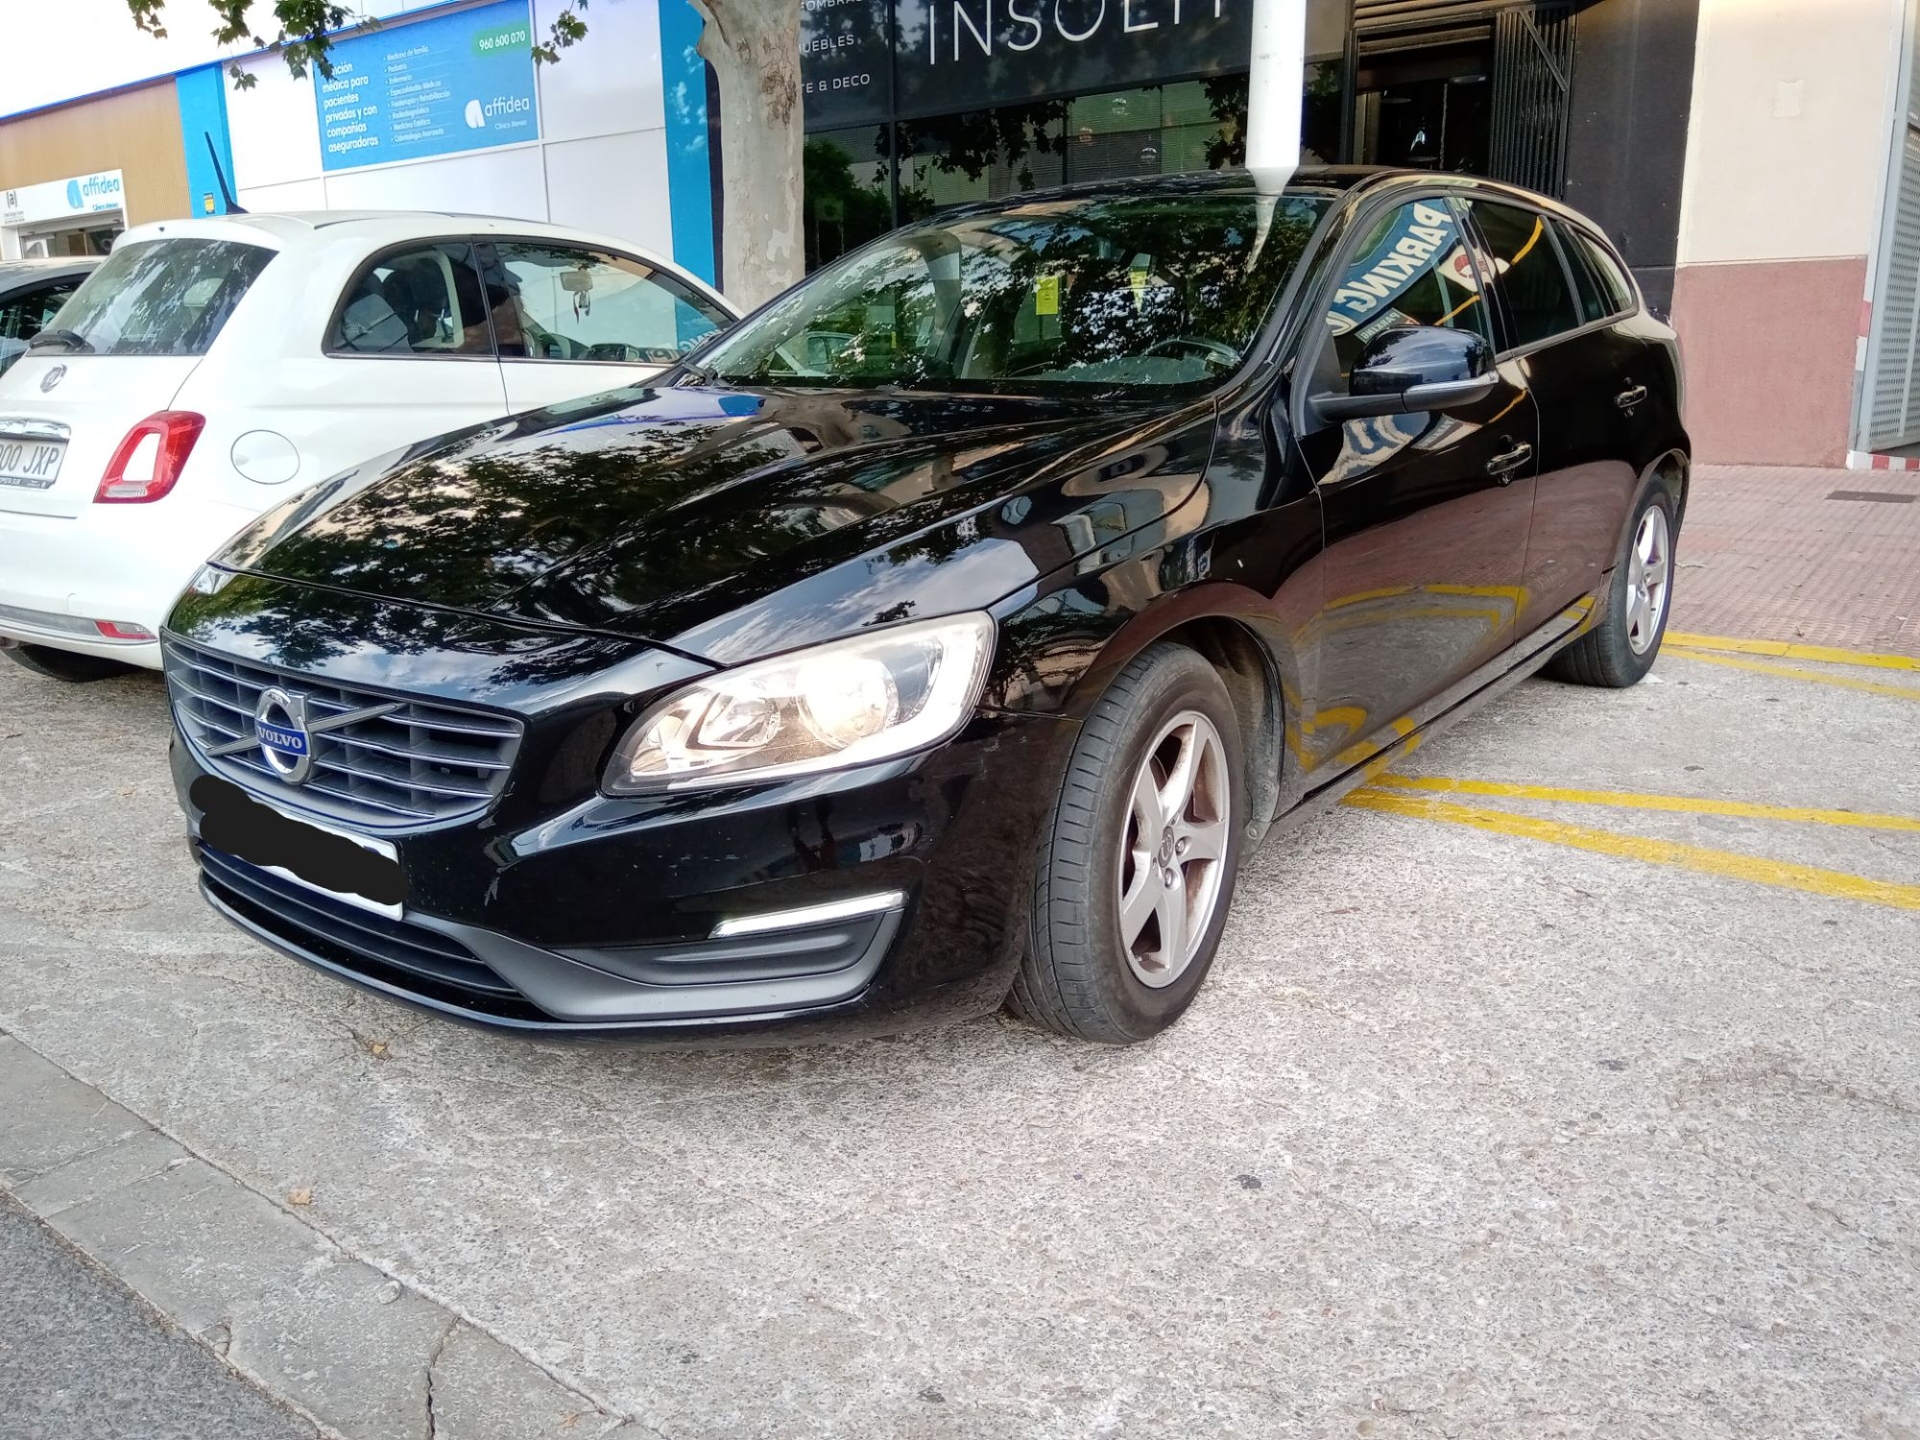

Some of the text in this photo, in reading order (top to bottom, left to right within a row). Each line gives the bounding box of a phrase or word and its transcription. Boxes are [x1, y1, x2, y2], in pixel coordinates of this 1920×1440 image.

[479, 30, 526, 51] 960 600 070
[798, 34, 855, 53] UEBLES
[350, 76, 369, 91] para
[818, 80, 828, 92] &
[832, 73, 871, 90] DECO
[324, 93, 359, 111] pacientes
[483, 95, 530, 117] affidea
[325, 105, 378, 127] privados y con
[327, 120, 367, 138] compañías
[328, 136, 379, 154] aseguradoras
[82, 175, 120, 197] affidea
[22, 446, 60, 476] JXP
[257, 726, 302, 749] VOLVO
